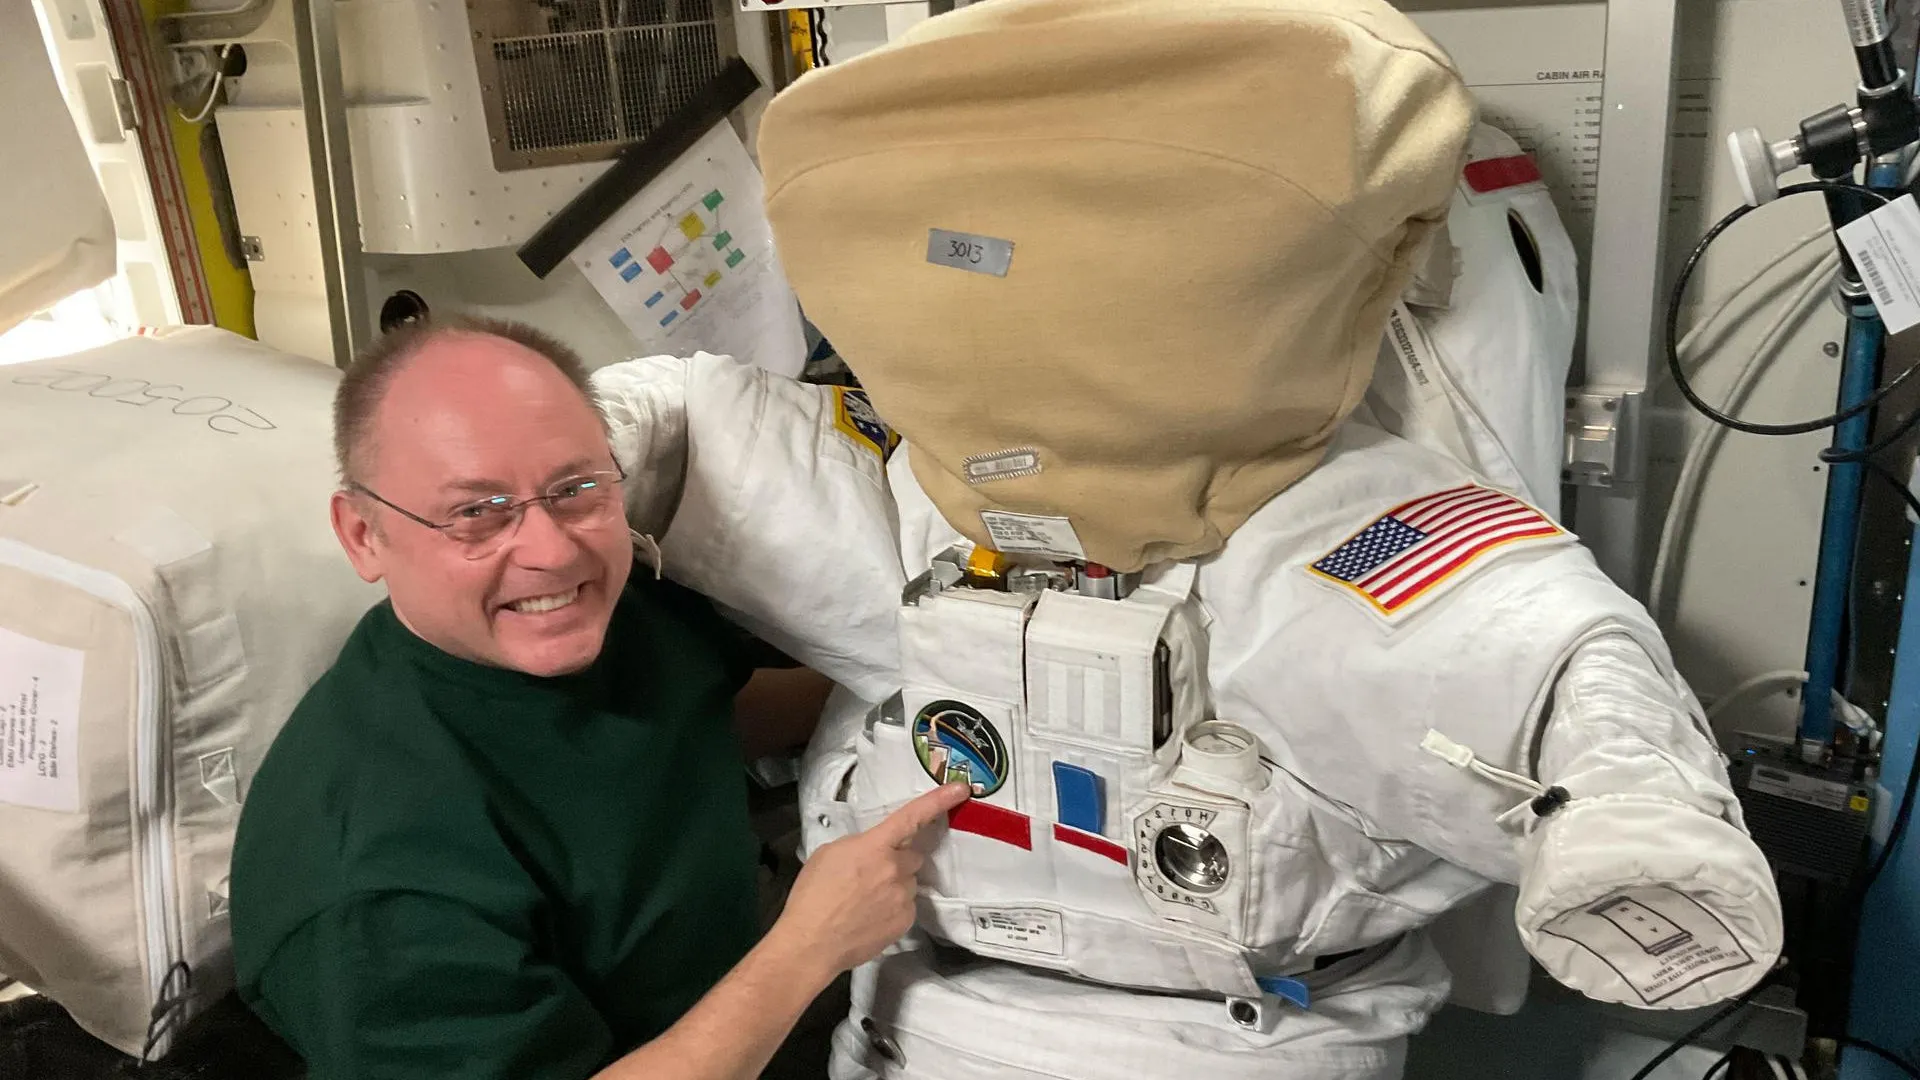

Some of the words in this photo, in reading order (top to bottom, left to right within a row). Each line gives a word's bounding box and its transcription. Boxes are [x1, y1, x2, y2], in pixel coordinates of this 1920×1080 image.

[1536, 71, 1569, 80] CABIN
[1572, 70, 1590, 79] AIR
[947, 240, 983, 264] 3013
[30, 690, 38, 715] Cover
[28, 716, 36, 760] Protective
